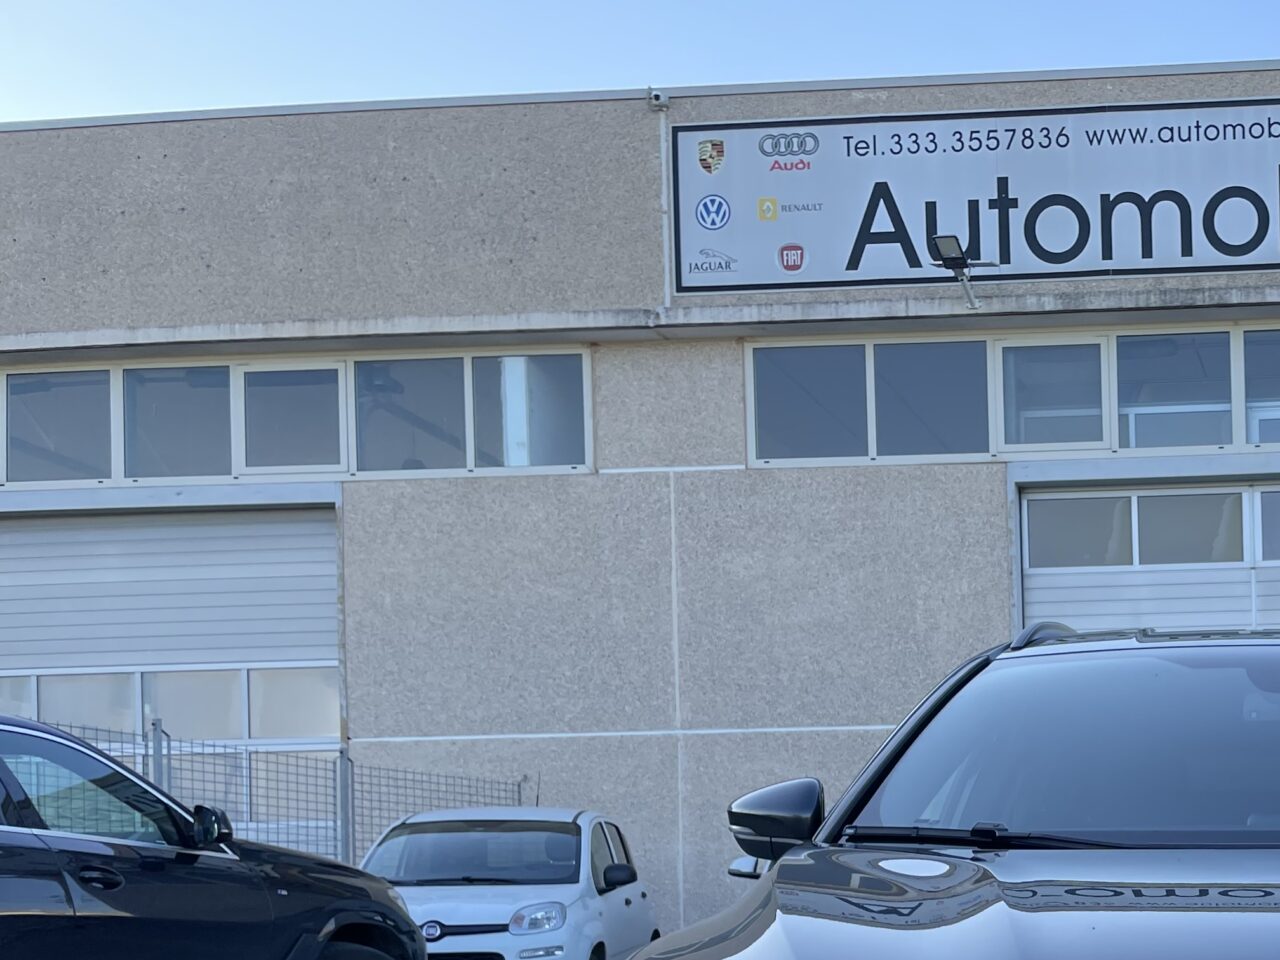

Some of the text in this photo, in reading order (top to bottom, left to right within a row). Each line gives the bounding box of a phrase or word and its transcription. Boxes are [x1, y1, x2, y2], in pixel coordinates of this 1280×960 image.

[842, 126, 1071, 158] Tel.333.3557836
[769, 158, 812, 172] Audi
[780, 202, 823, 213] RENAULT
[782, 249, 802, 266] FIAT
[688, 260, 732, 274] JAGUAR
